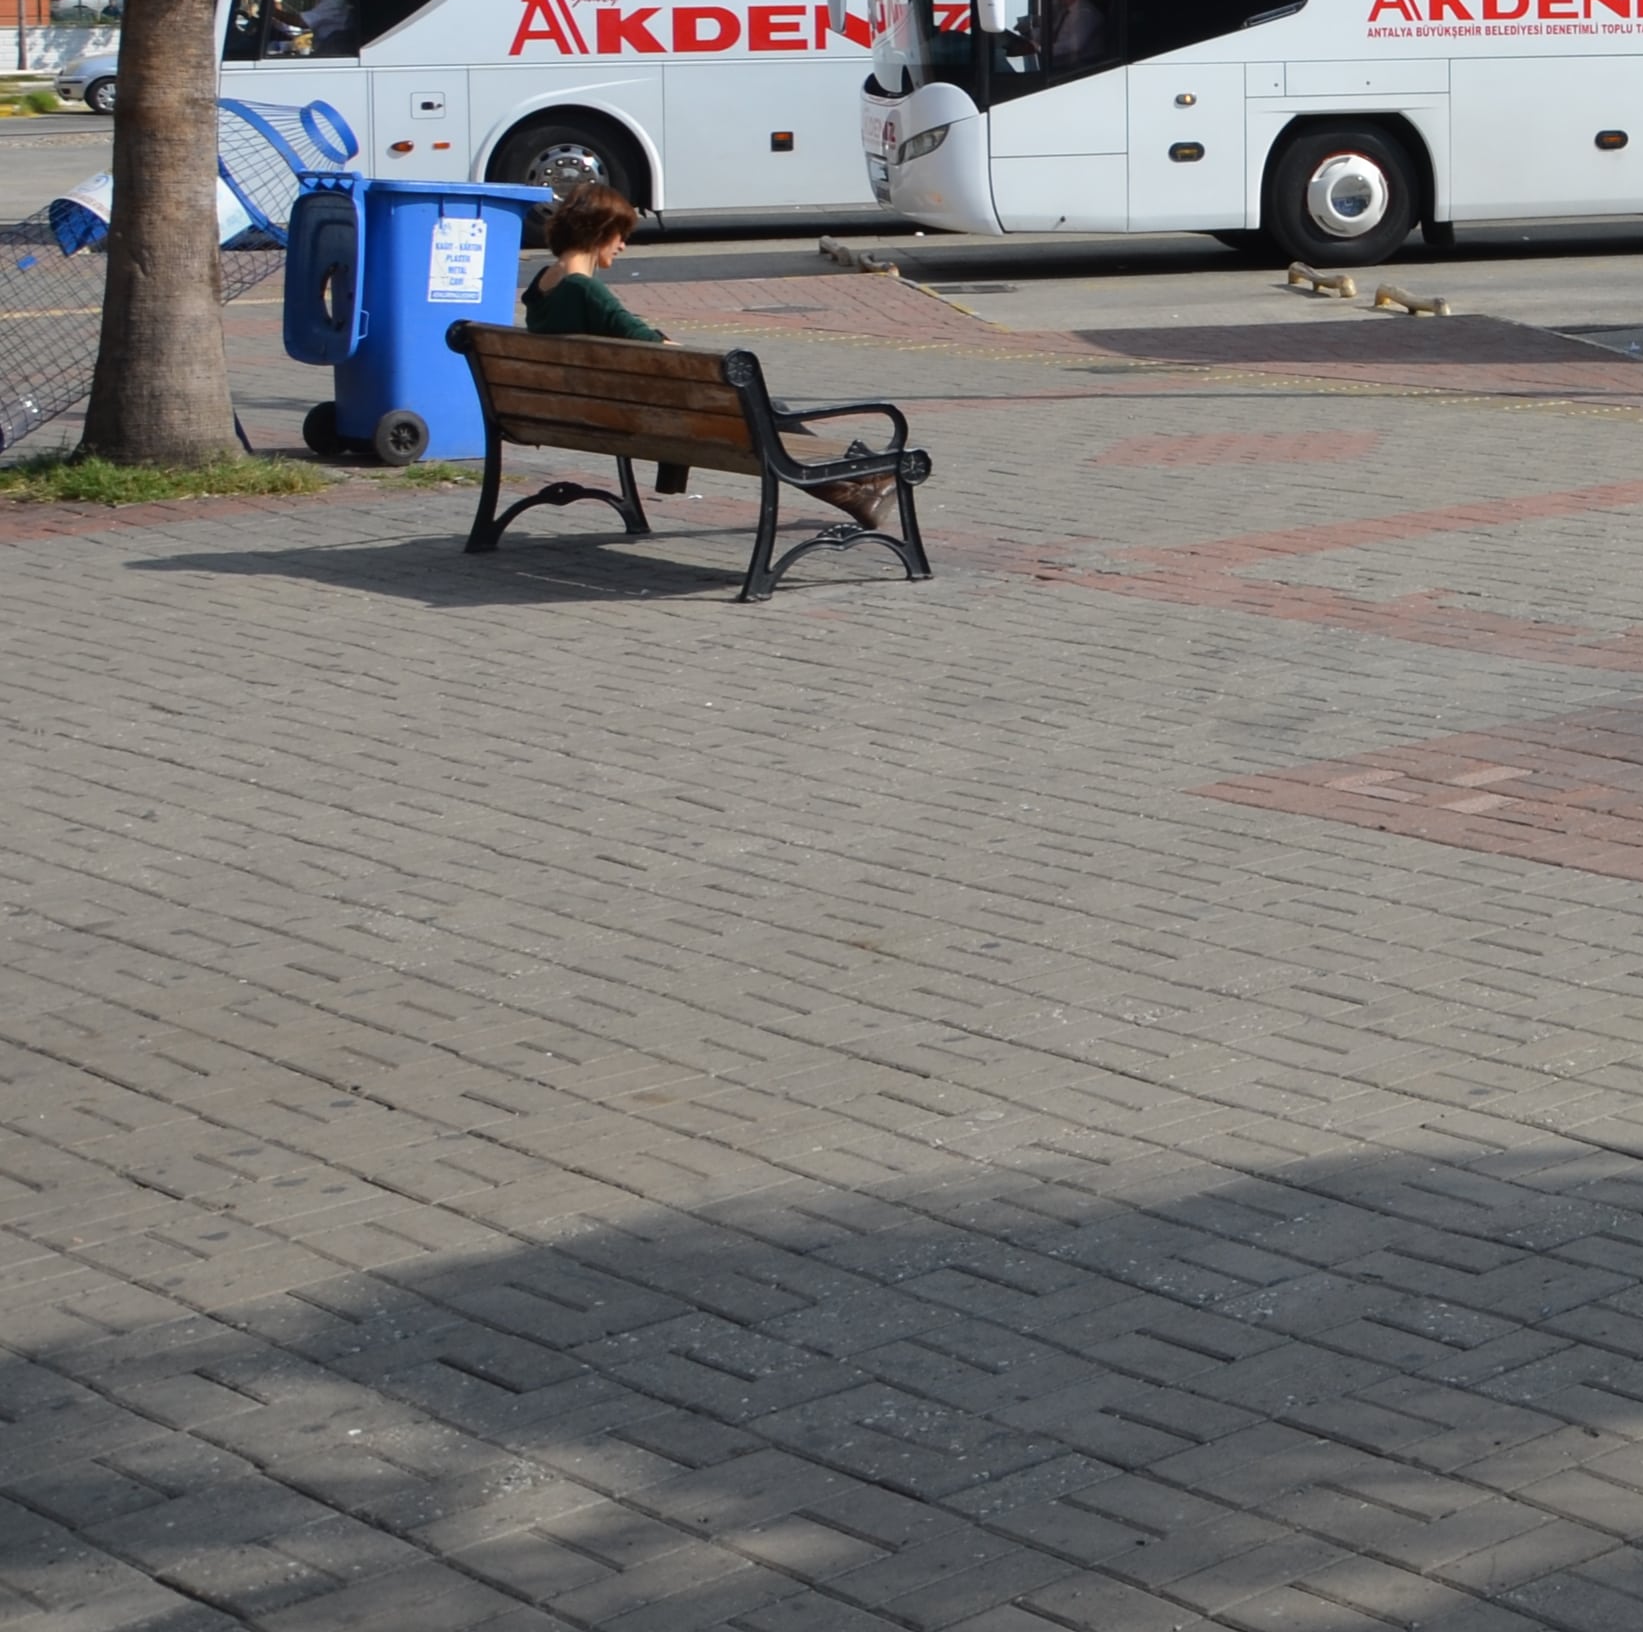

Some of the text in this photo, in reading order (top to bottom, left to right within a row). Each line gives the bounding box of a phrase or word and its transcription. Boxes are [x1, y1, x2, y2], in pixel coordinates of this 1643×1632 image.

[1367, 27, 1413, 38] ANTALYA
[1416, 24, 1481, 39] BÜYÜKŞEHİR
[1485, 23, 1543, 36] BELEDİYESİ
[1546, 22, 1598, 35] DENETİMLİ
[1602, 23, 1633, 34] TOPLU
